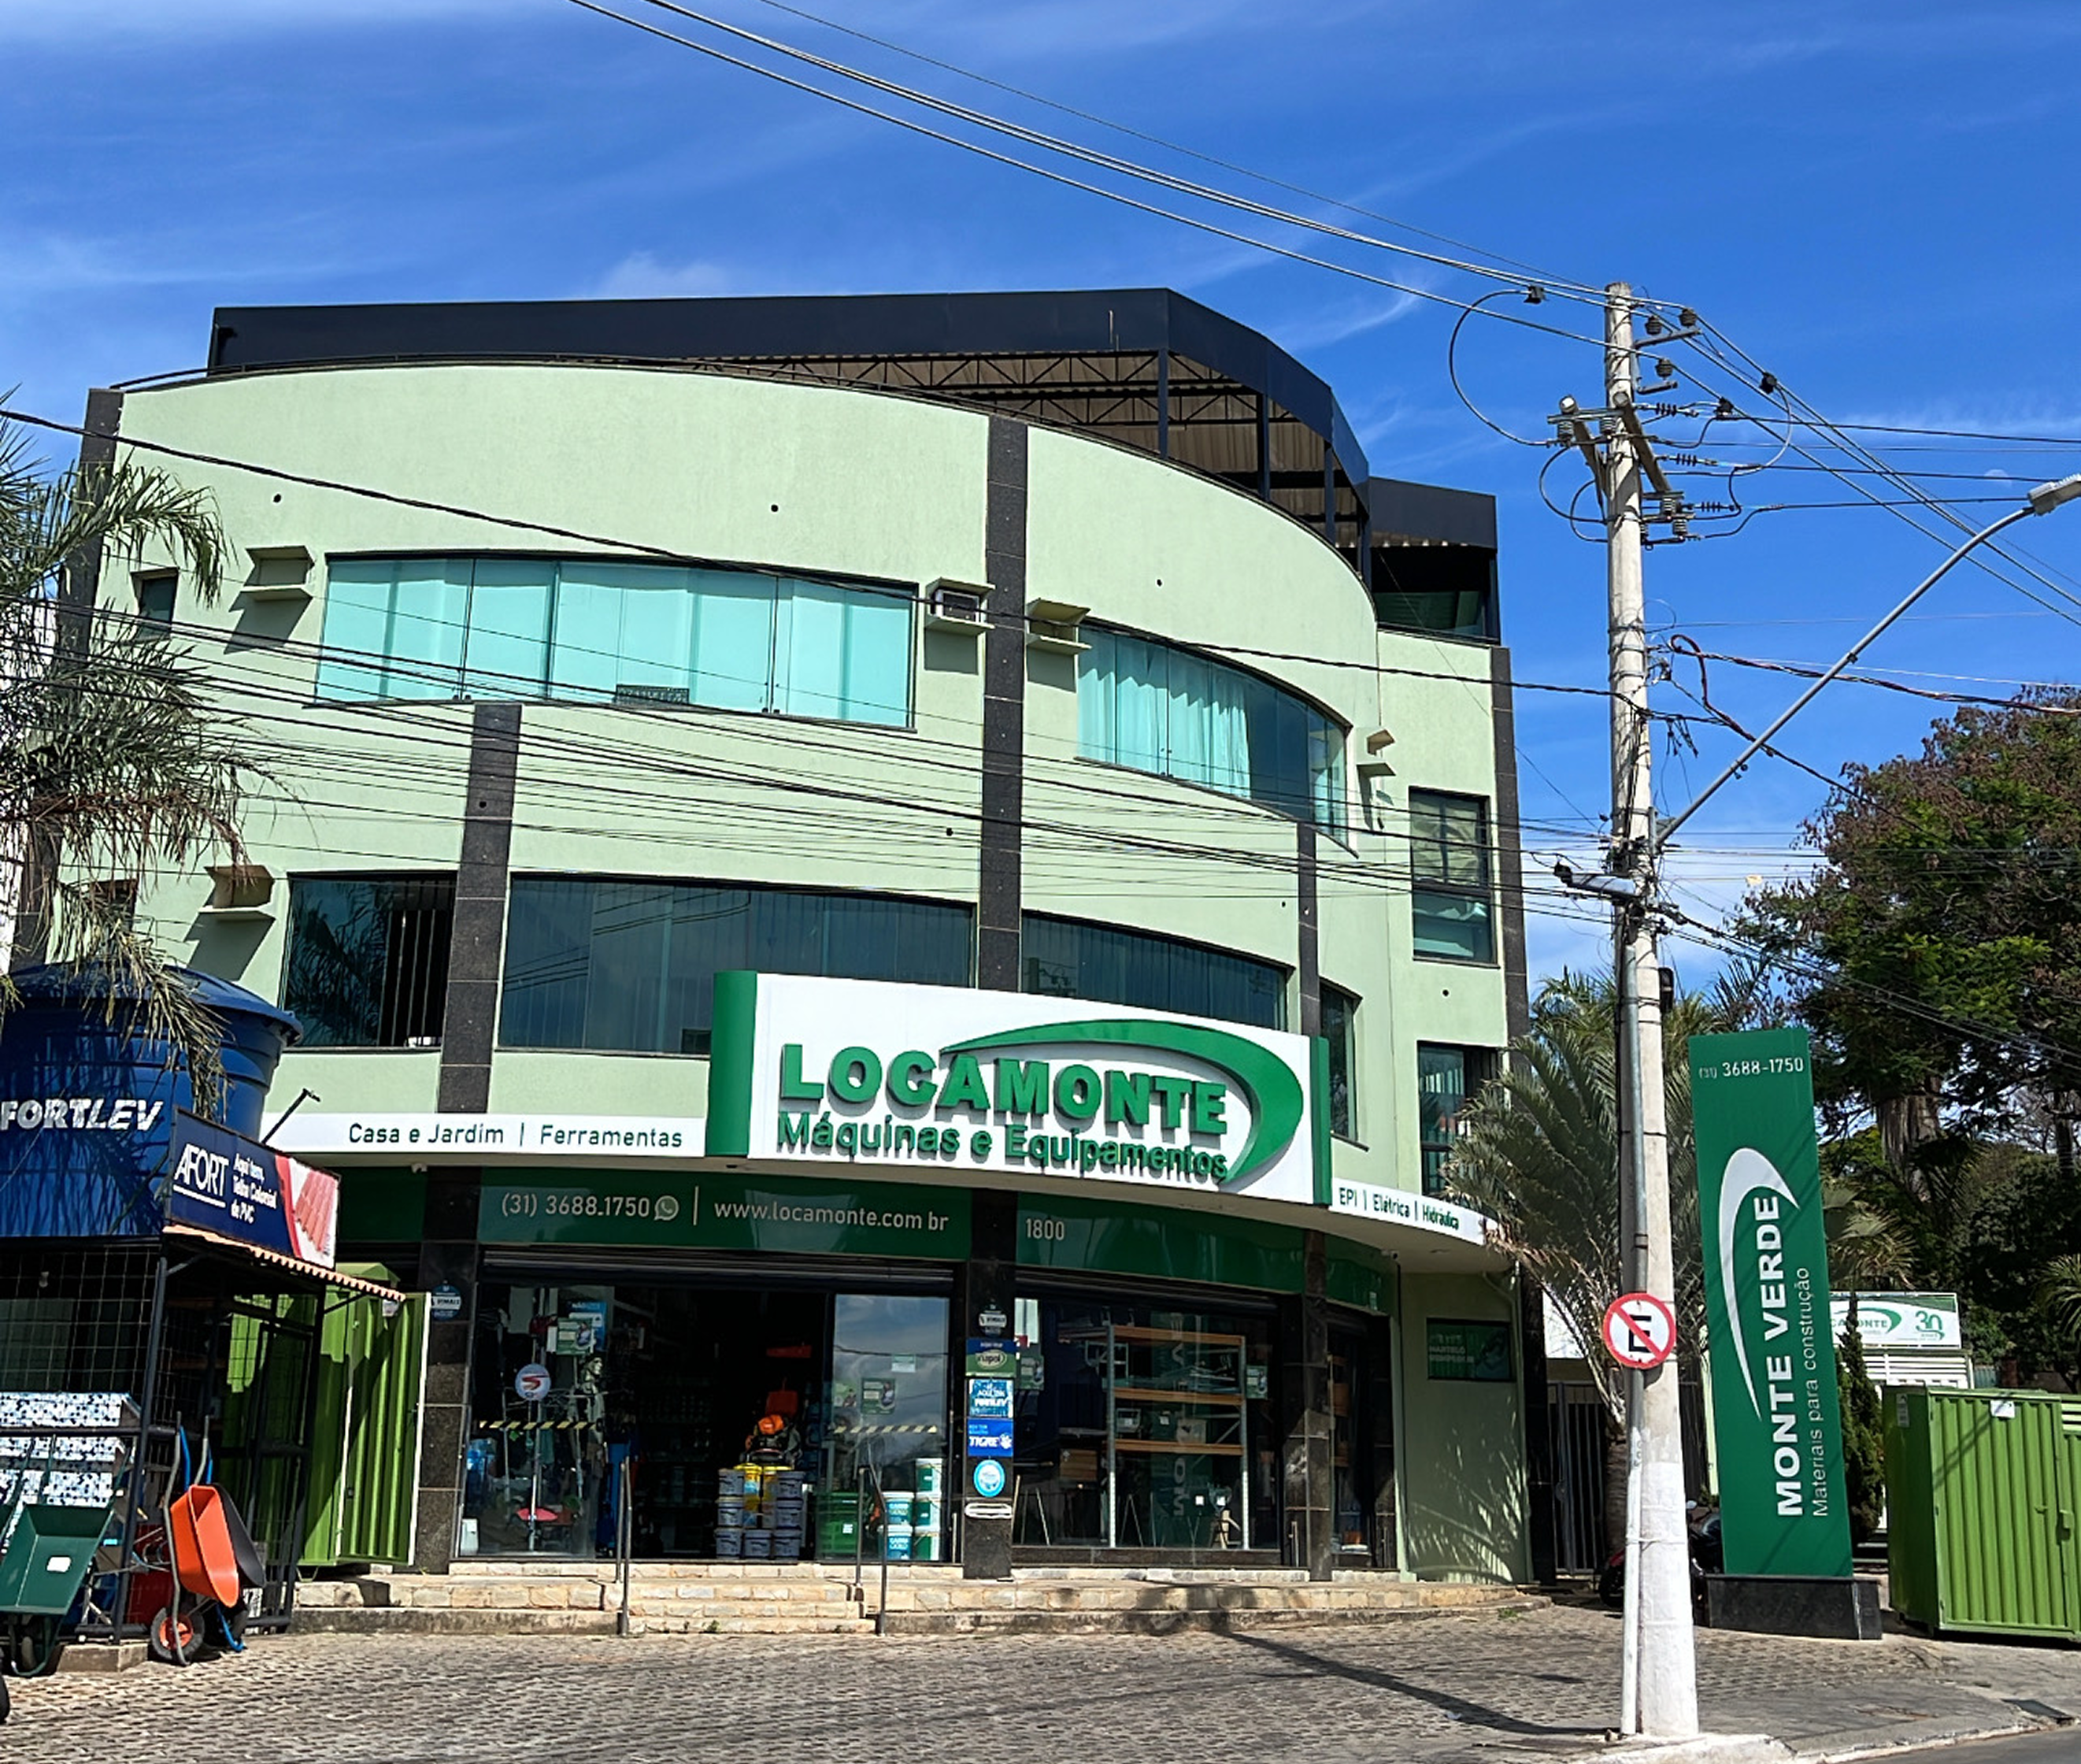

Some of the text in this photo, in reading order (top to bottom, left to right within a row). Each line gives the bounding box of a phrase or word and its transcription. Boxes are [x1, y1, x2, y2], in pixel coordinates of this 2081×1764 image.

[1722, 1057, 1804, 1077] 3688-1750
[780, 1043, 1227, 1136] LOCAMONTE
[0, 1099, 164, 1131] FORTLEV
[349, 1123, 504, 1143] Casa e Jardim
[540, 1124, 683, 1147] Ferramentas
[778, 1111, 1228, 1180] Máquinas e Equipamentos
[174, 1143, 229, 1198] AFORT
[502, 1192, 650, 1217] (31) 3688.1750
[1339, 1188, 1357, 1207] EPI
[1025, 1218, 1065, 1241] 1800
[1831, 1318, 1888, 1329] CAONTE
[1753, 1195, 1804, 1516] MONTE VERDE
[1794, 1268, 1828, 1516] Materiais para construção
[968, 1436, 1000, 1447] TIGRE
